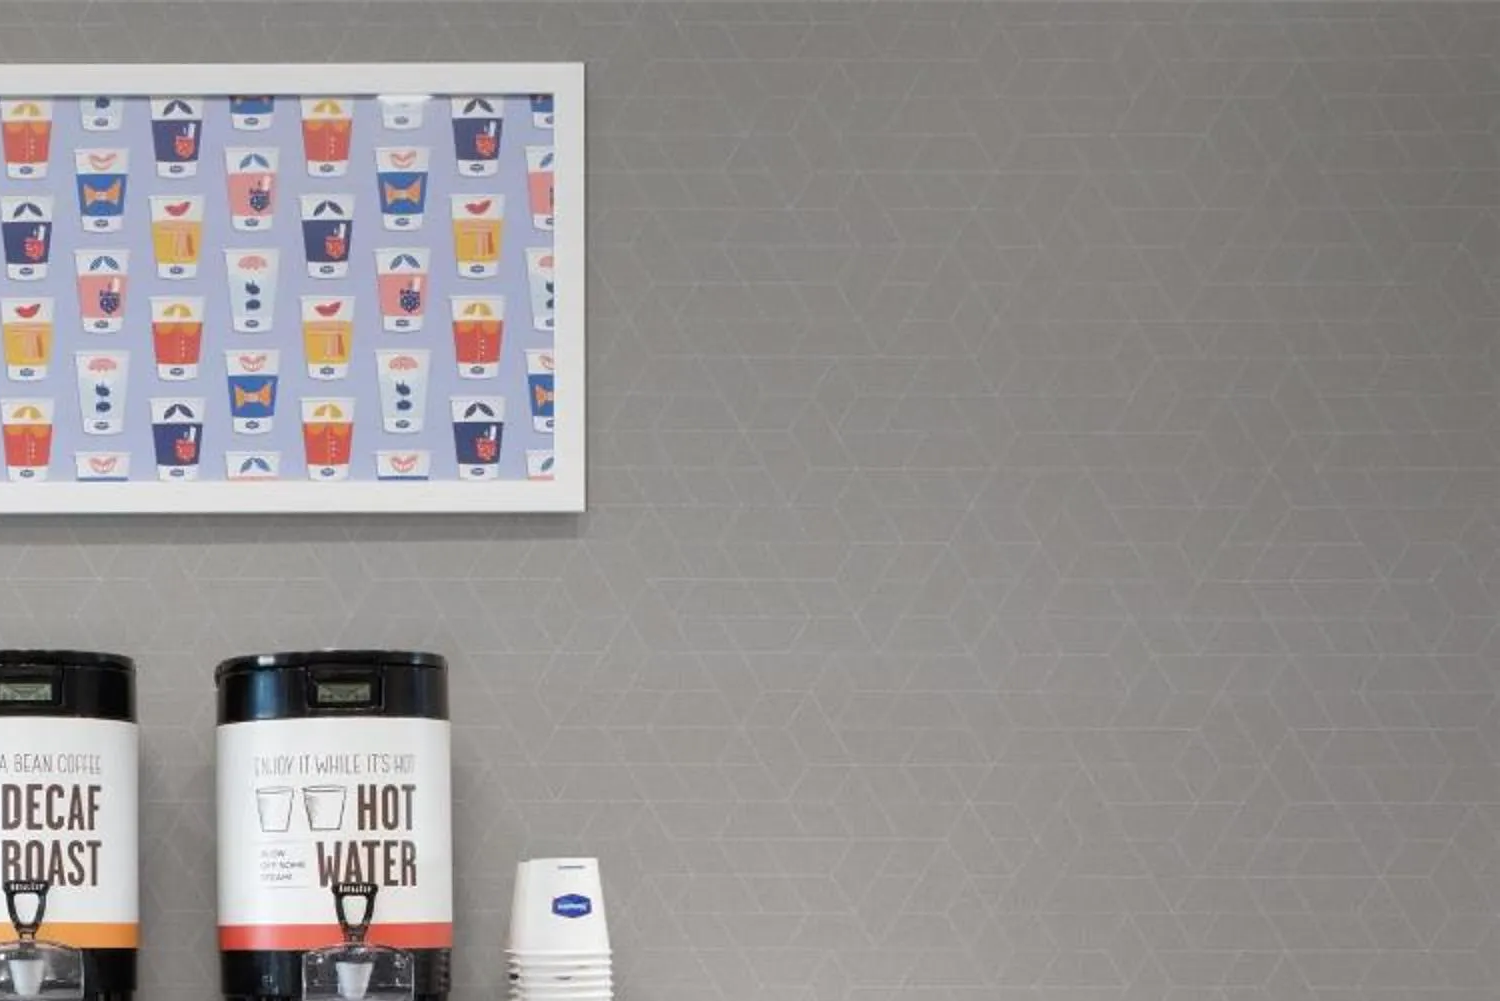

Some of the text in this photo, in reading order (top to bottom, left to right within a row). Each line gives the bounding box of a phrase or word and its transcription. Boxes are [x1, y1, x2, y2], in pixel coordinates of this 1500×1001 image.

[14, 753, 53, 773] BEAN
[57, 753, 101, 775] COFFEE
[254, 754, 294, 777] ENJOY
[298, 753, 310, 775] IT
[315, 753, 361, 775] WHILE
[394, 754, 415, 774] HOT
[1, 783, 102, 831] DECAF
[357, 783, 416, 831] HOT
[2, 840, 102, 886] ROAST
[316, 840, 417, 888] WATER
